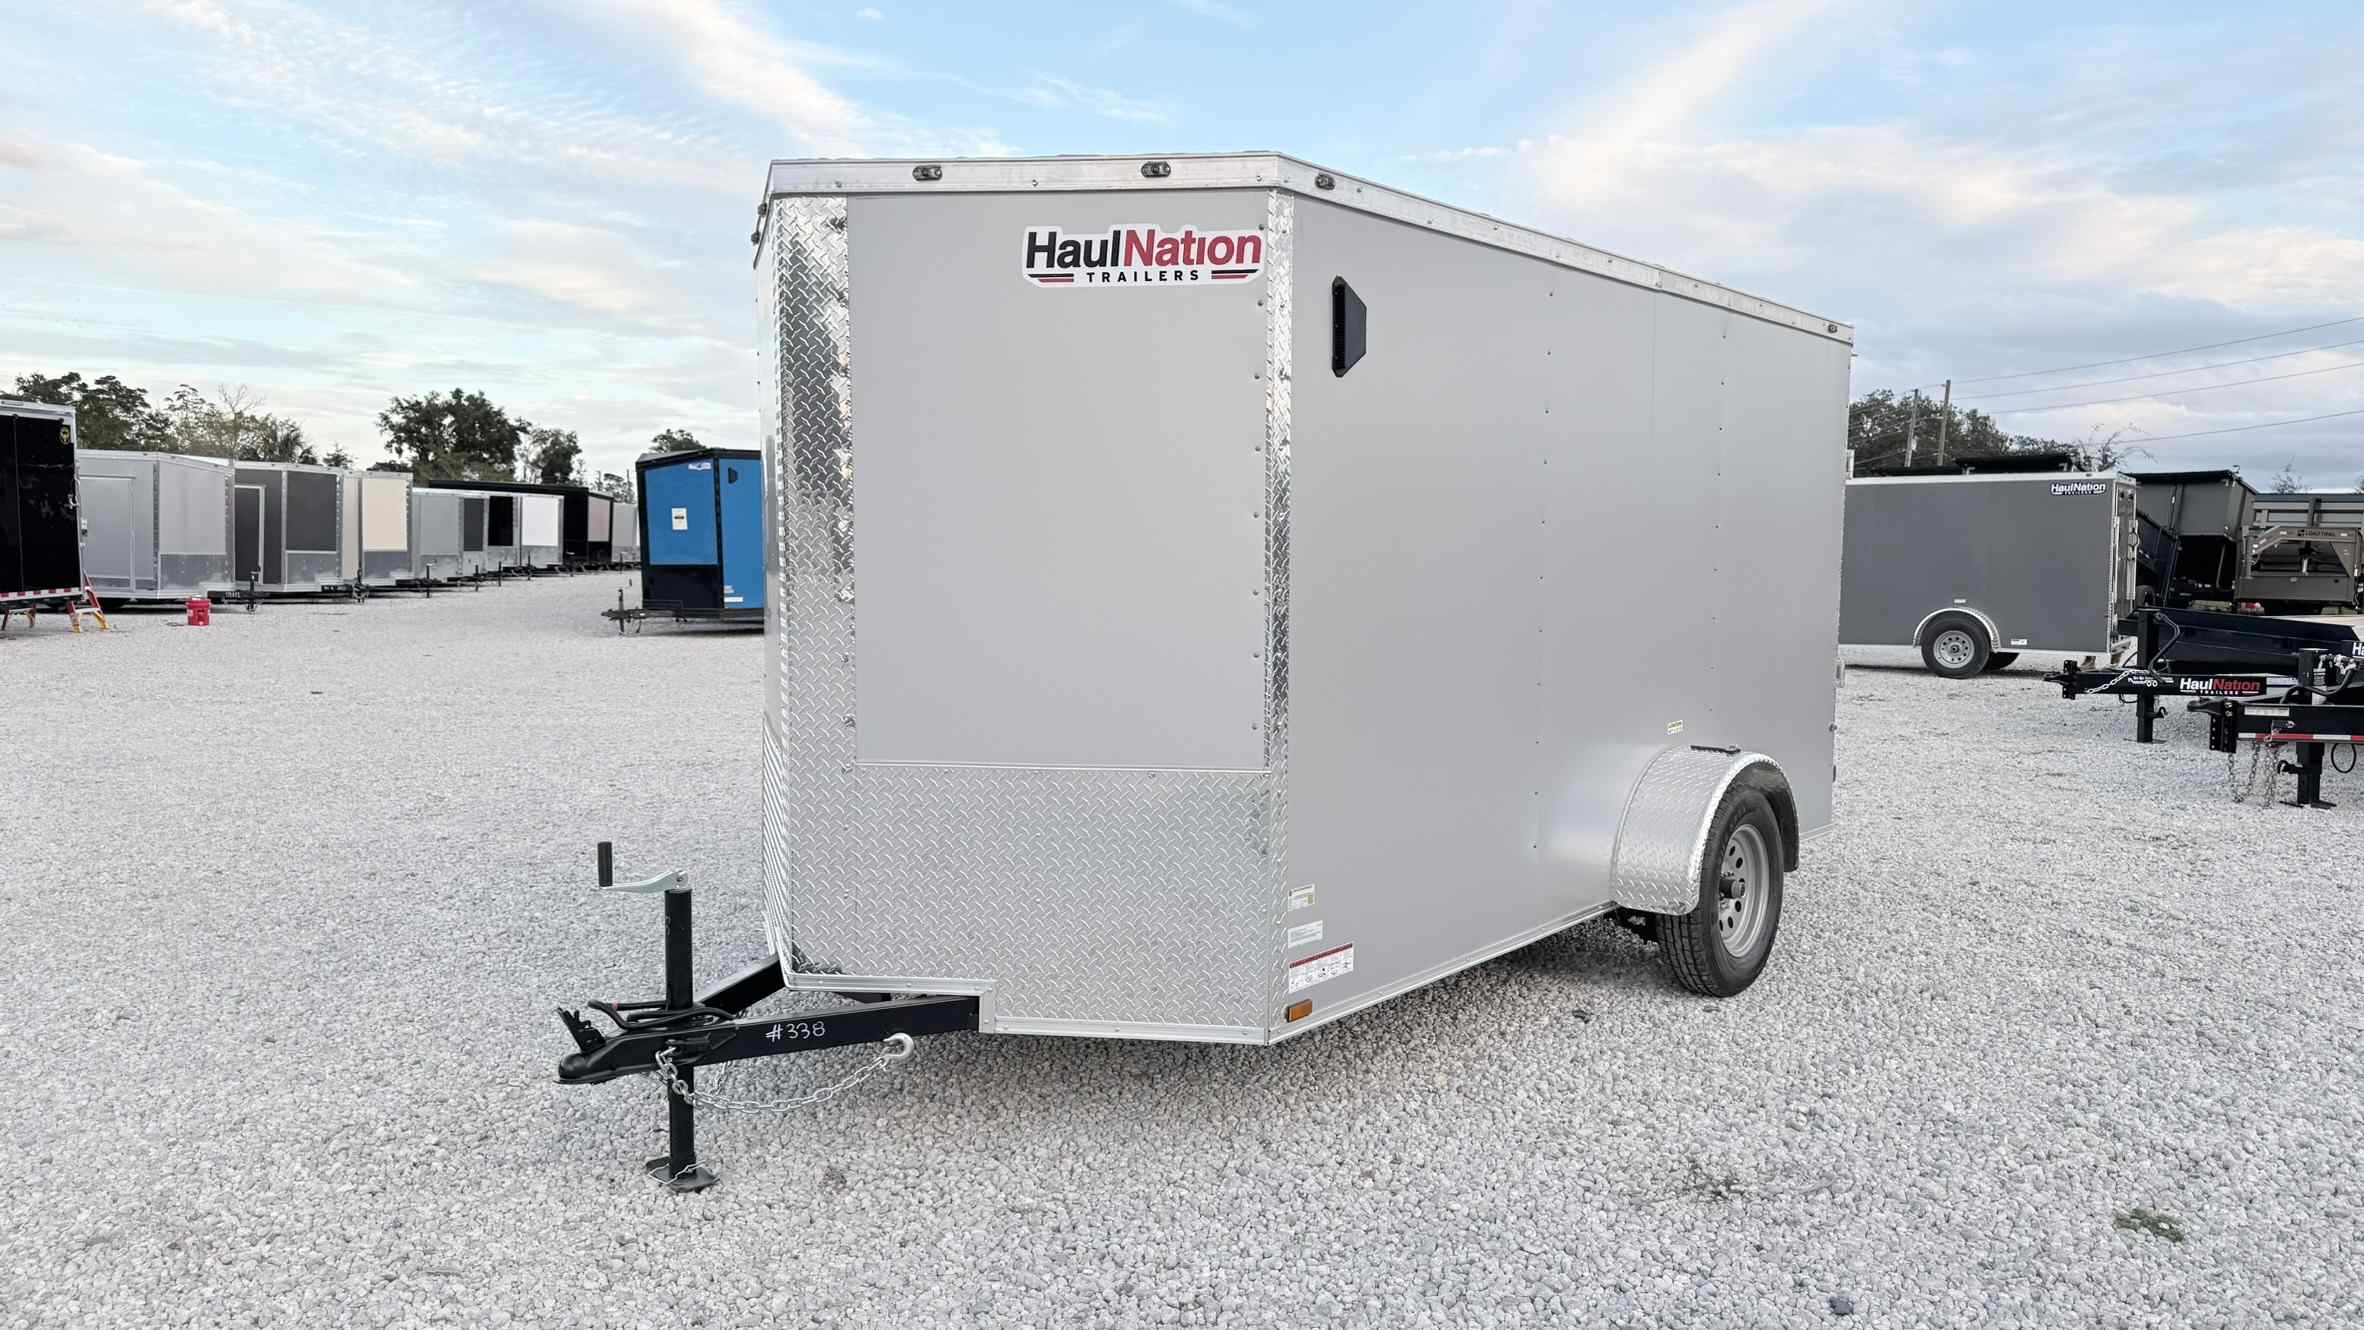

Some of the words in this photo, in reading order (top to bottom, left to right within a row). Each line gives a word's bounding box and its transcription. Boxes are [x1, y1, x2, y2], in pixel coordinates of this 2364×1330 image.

[1026, 229, 1262, 269] HaulNation
[1086, 270, 1200, 283] TRAILERS
[2051, 482, 2106, 492] HaulNation
[2180, 677, 2260, 691] HaulNation
[765, 1021, 826, 1042] #338
